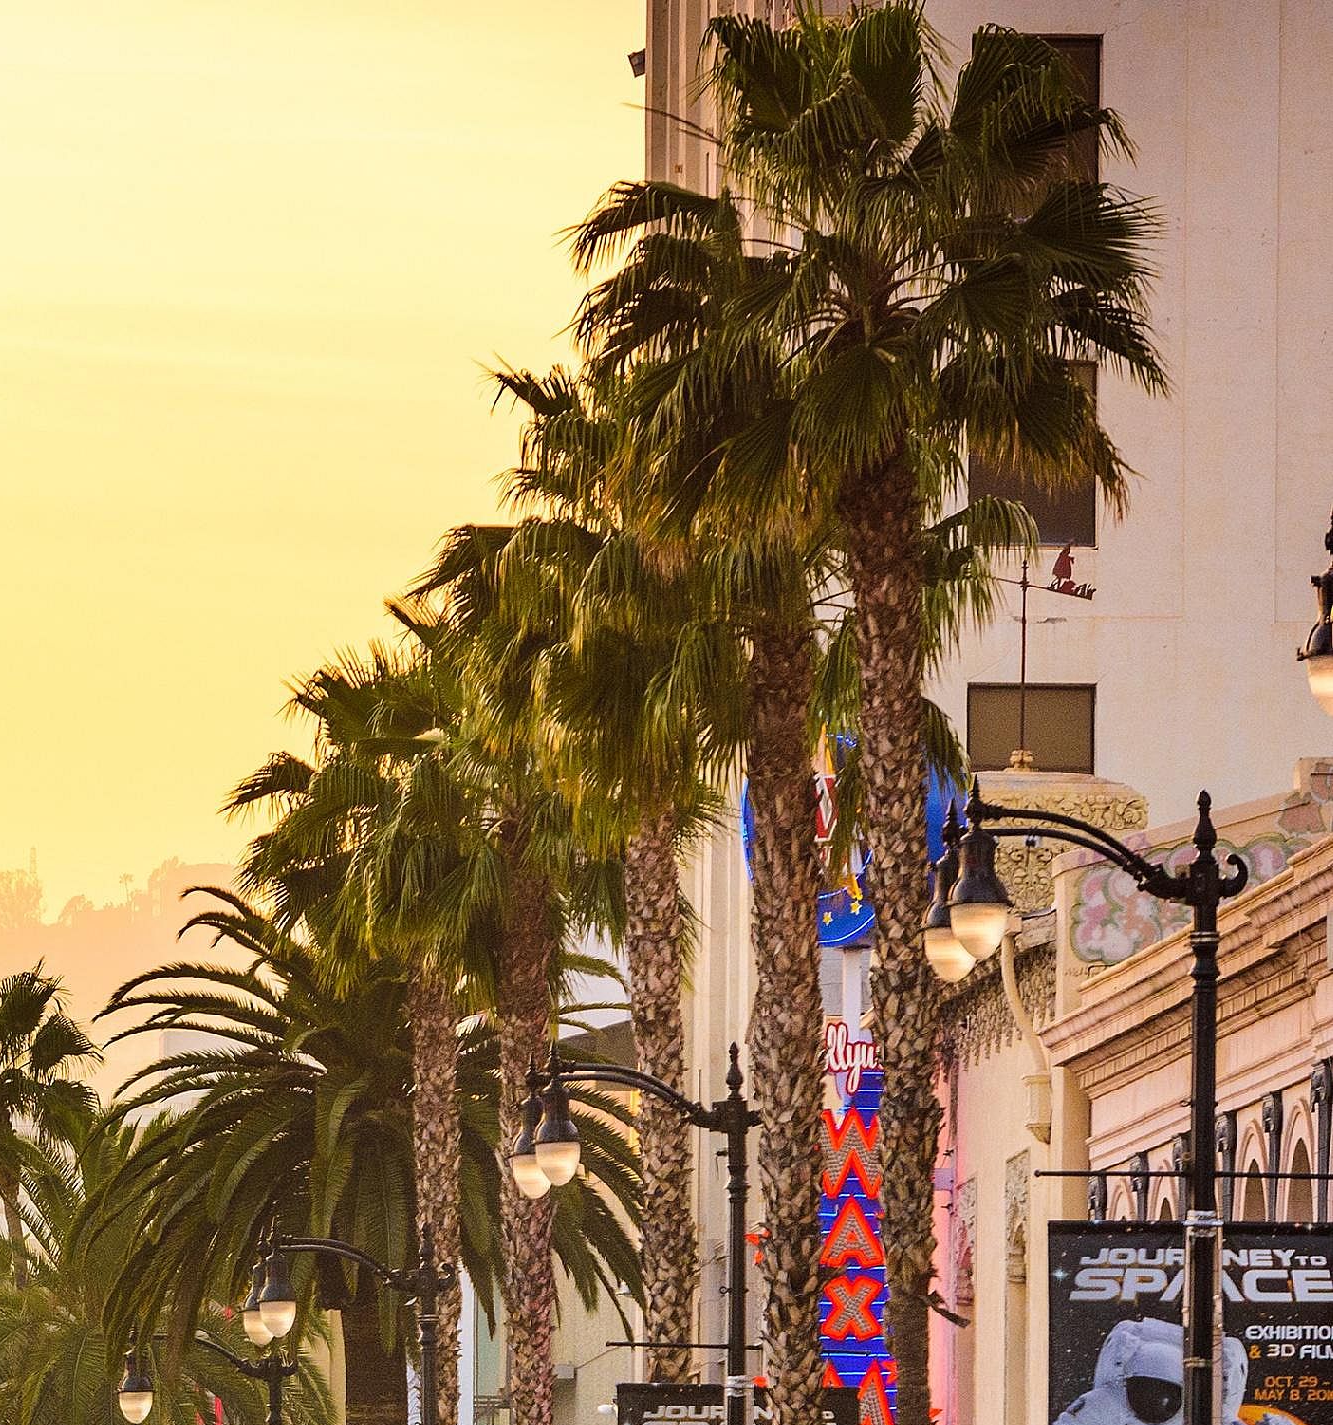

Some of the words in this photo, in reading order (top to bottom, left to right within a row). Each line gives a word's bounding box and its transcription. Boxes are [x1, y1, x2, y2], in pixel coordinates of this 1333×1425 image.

[821, 1106, 884, 1337] WAX
[1295, 1256, 1328, 1266] TO
[1267, 1344, 1296, 1358] 3D
